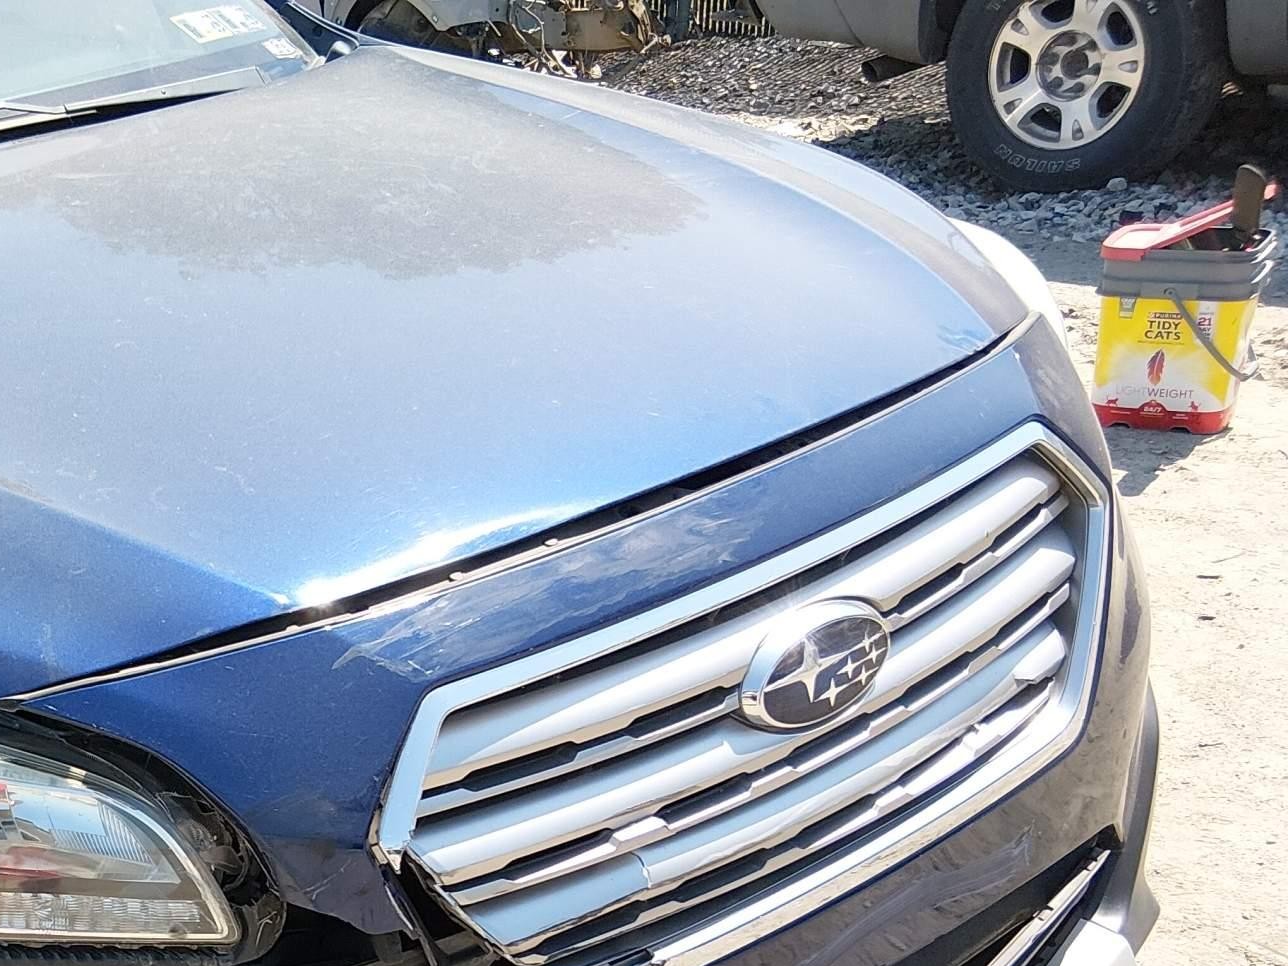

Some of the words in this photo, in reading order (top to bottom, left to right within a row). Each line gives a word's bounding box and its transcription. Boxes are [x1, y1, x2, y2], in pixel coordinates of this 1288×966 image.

[1147, 320, 1181, 331] TIDY
[1198, 317, 1212, 326] 21
[1144, 330, 1181, 341] CATS
[1116, 385, 1194, 399] LIGHTWEIGHT
